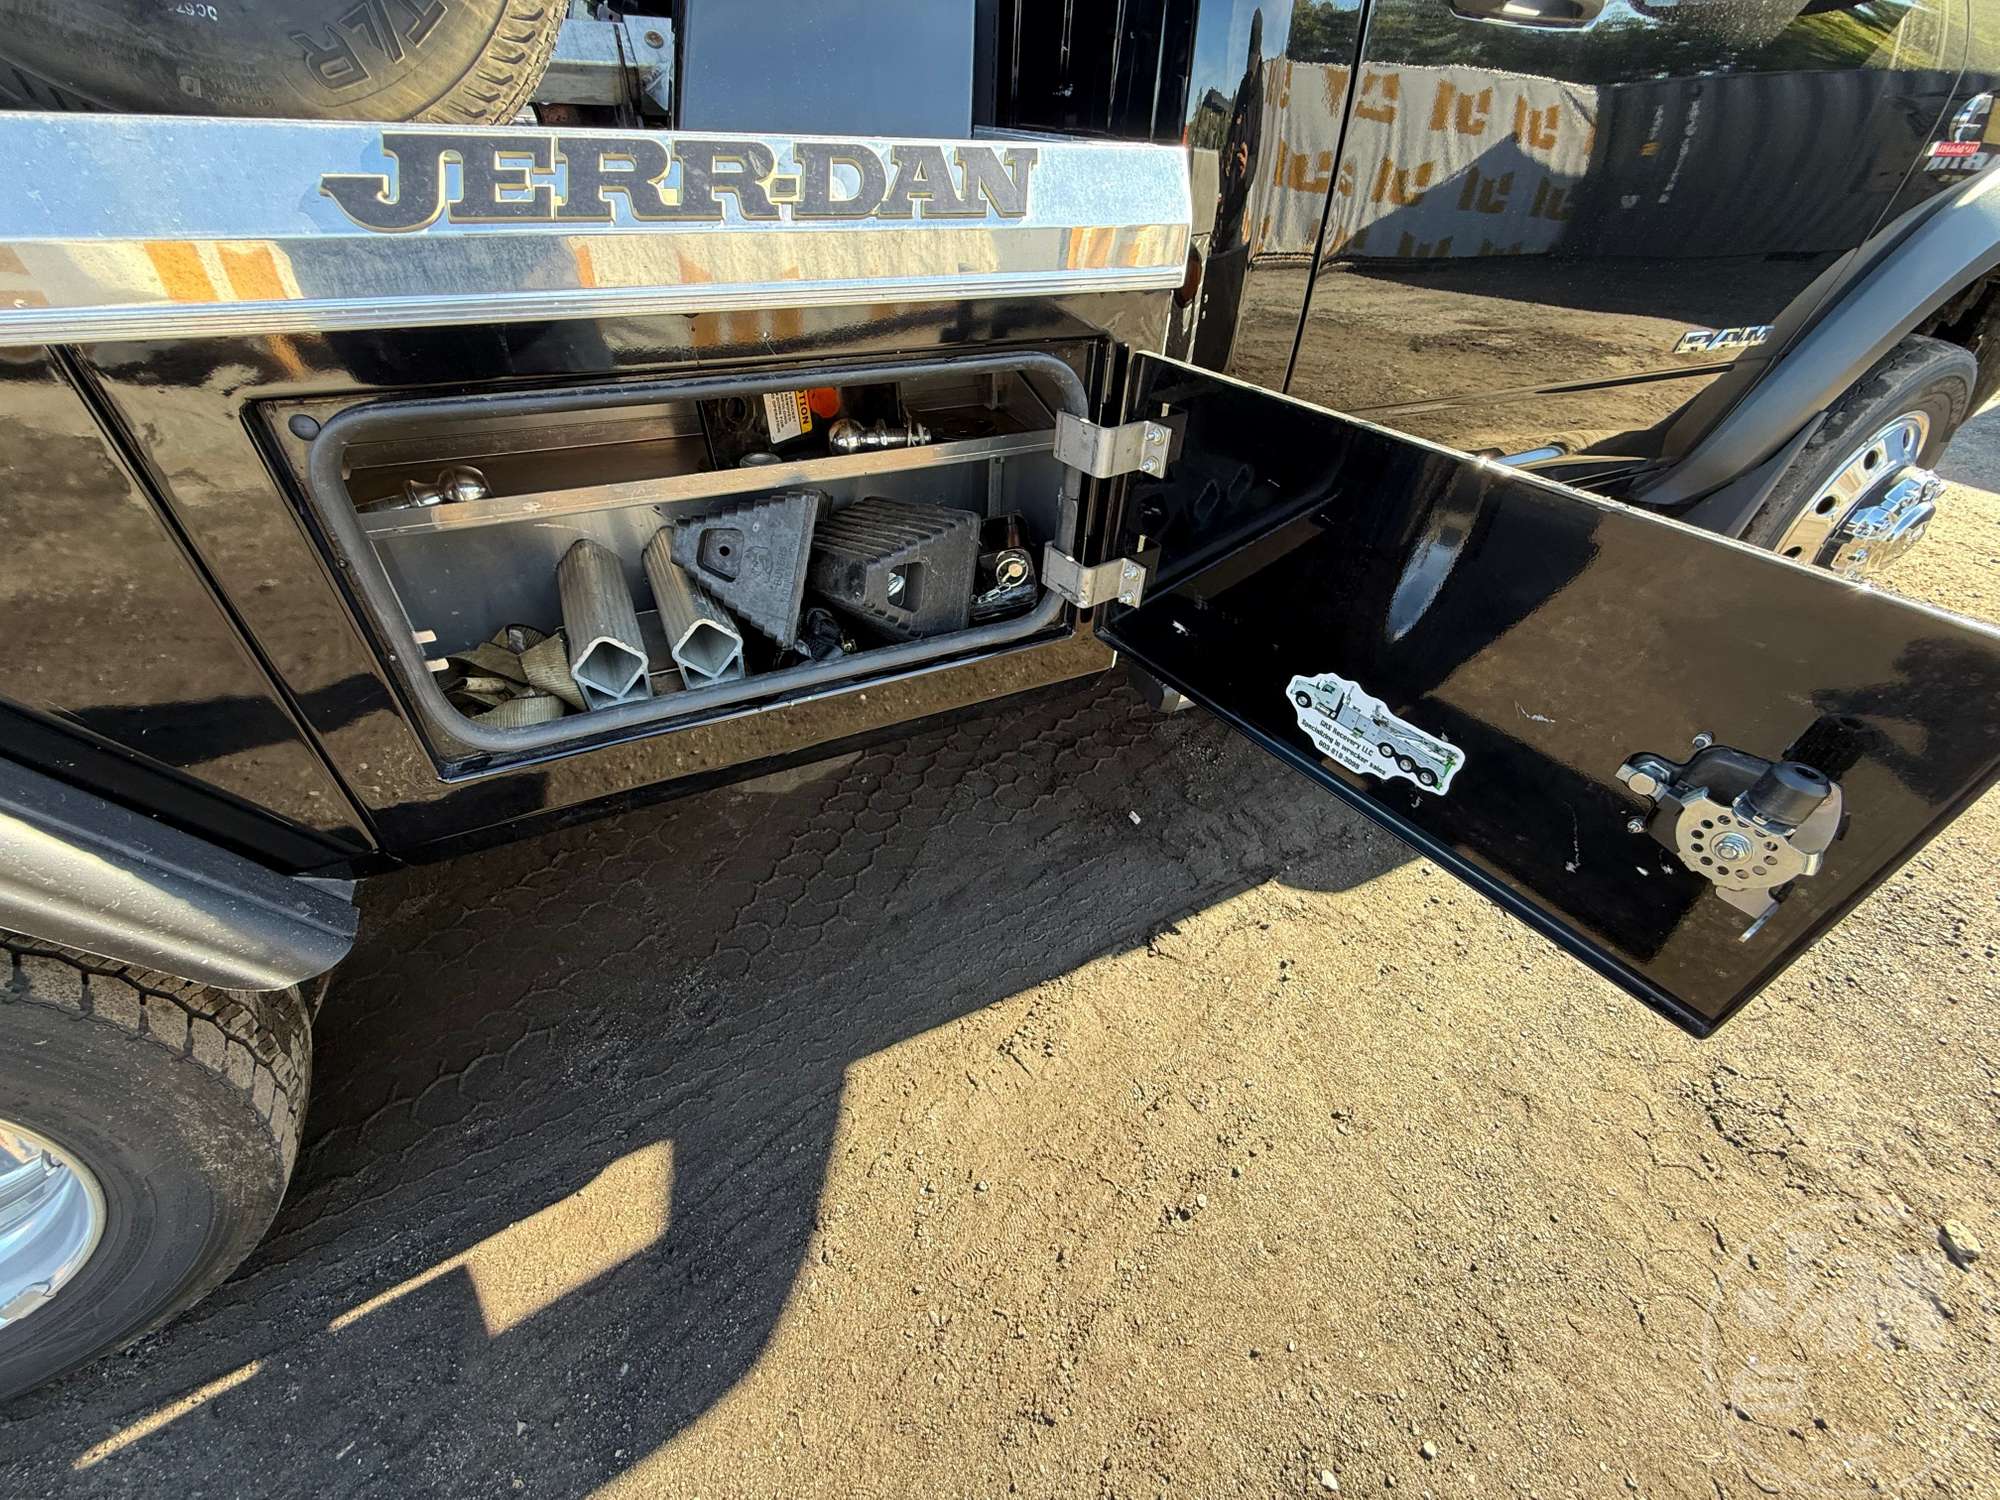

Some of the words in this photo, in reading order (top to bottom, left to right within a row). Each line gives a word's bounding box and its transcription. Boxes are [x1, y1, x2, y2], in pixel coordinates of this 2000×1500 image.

[320, 131, 1038, 233] JERR-DAN
[1672, 325, 1775, 354] RAM
[799, 390, 809, 424] TION
[1333, 726, 1360, 749] Recovery
